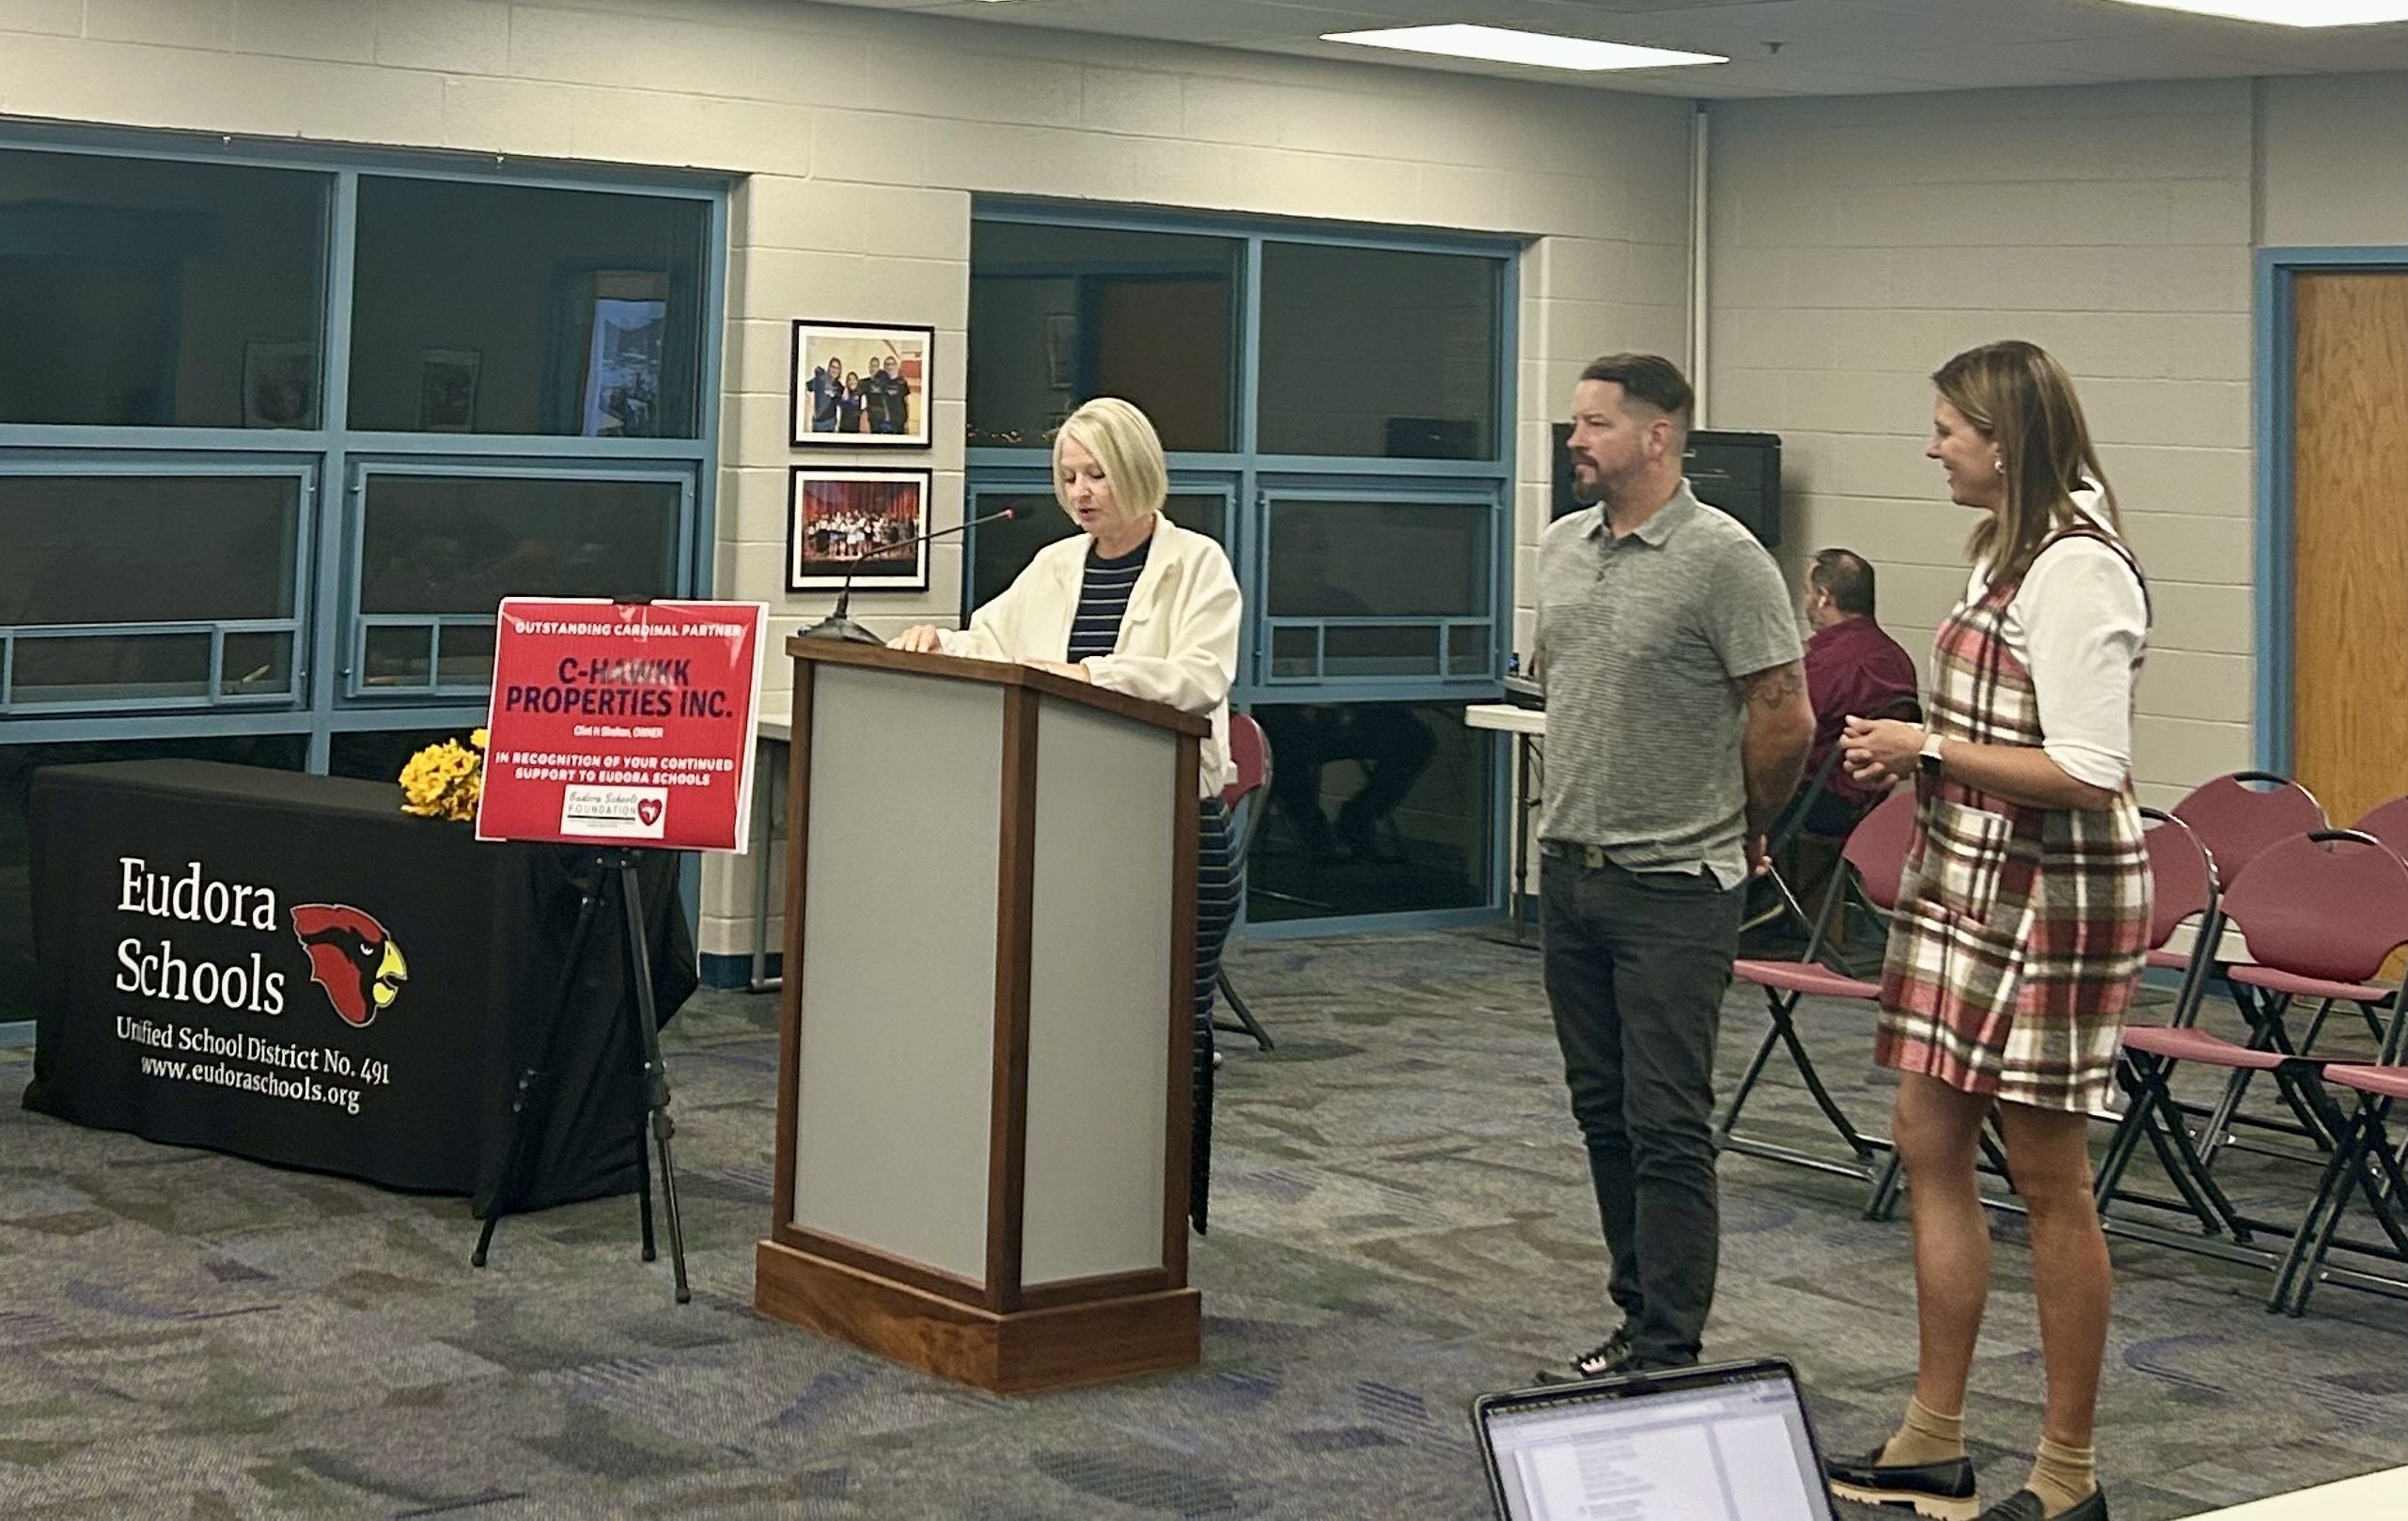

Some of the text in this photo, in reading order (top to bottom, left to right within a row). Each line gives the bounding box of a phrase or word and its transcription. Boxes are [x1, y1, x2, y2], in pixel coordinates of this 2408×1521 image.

[515, 621, 743, 638] OUTSTANDING CARDINAL PARTNER
[558, 657, 691, 687] C-HAWKK
[506, 686, 733, 718] PROPERTIES INC.
[495, 751, 734, 772] IN RECOGNITION OF YOUR CONTINUED
[515, 767, 711, 787] SUPPORT TO EUDORA SCHOOLS
[568, 803, 636, 816] FOUNDATION
[117, 857, 277, 932] Eudora
[116, 938, 285, 1015] Schools
[116, 1015, 390, 1085] Unified School District No. 491
[141, 1055, 361, 1115] www.eudoraschools.org
